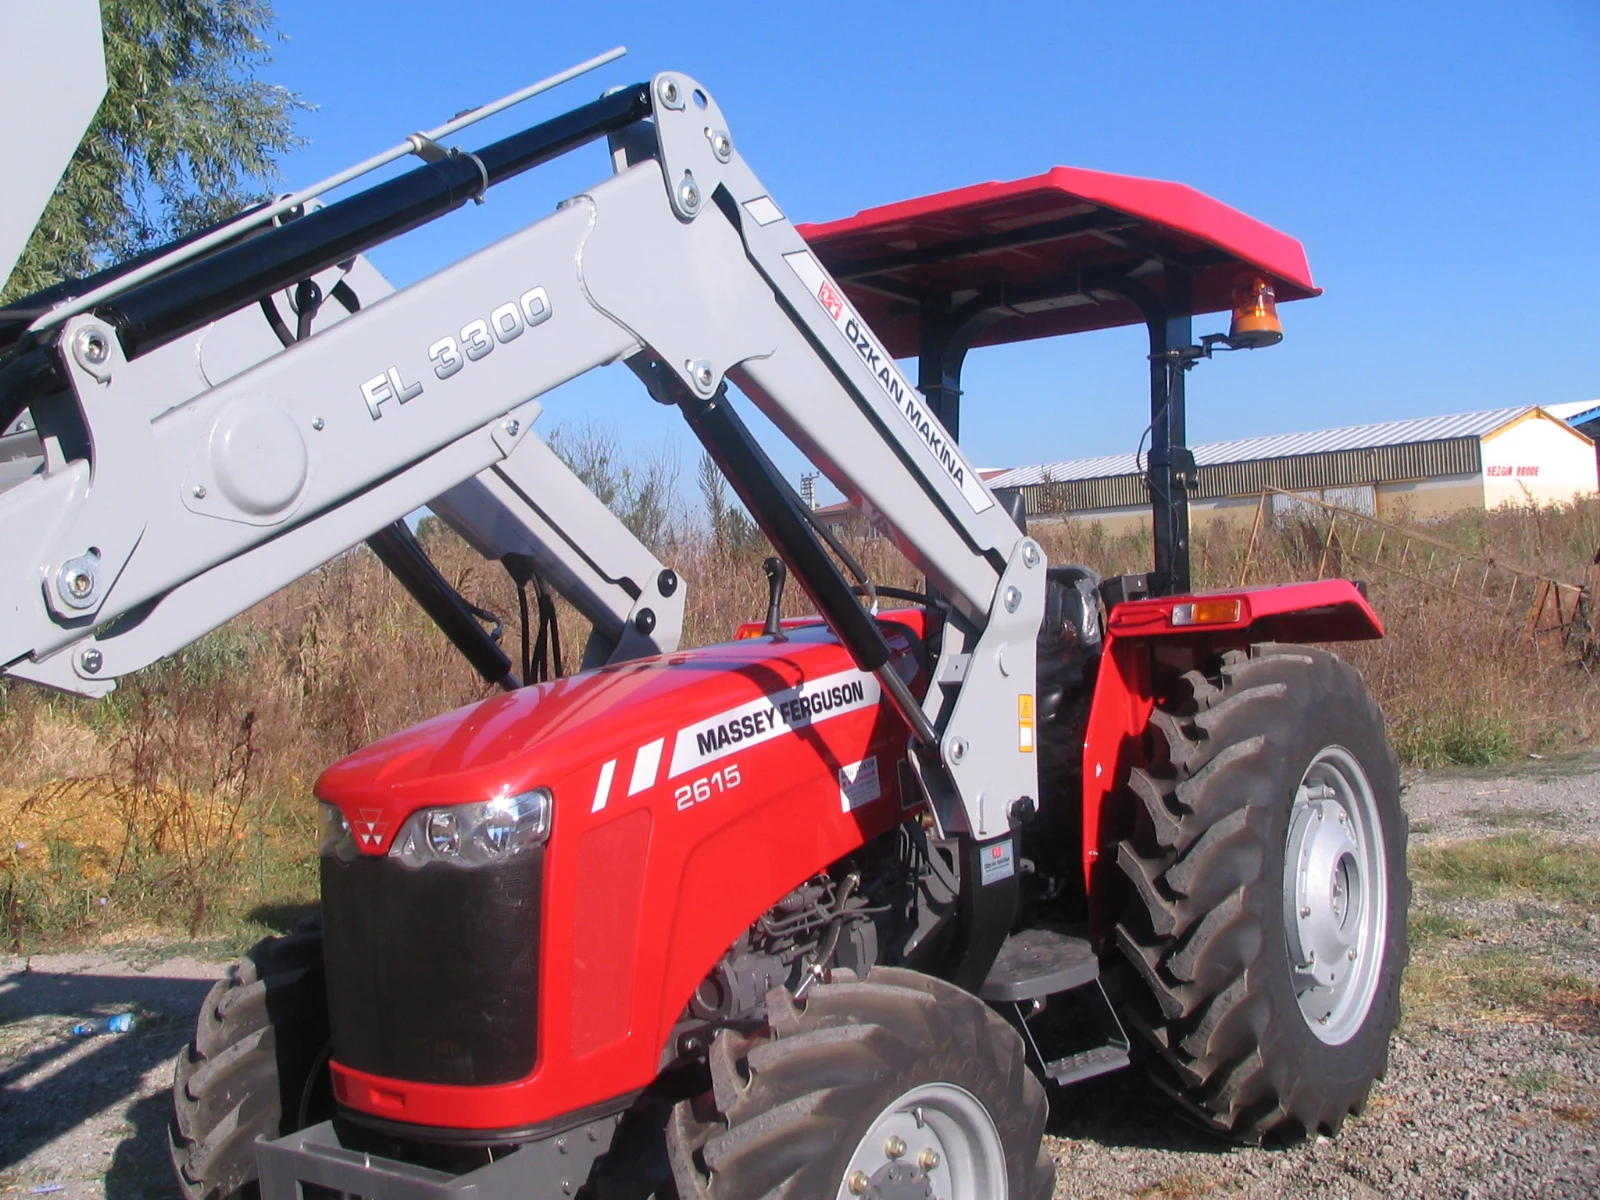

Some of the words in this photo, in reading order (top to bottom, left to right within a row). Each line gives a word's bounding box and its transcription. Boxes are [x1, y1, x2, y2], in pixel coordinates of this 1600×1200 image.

[360, 366, 424, 421] FL
[428, 286, 553, 380] 3300
[845, 318, 903, 405] ÖZKAN
[696, 708, 775, 756] MASSEY
[780, 680, 865, 724] FERGUSON
[674, 764, 742, 812] 2615
